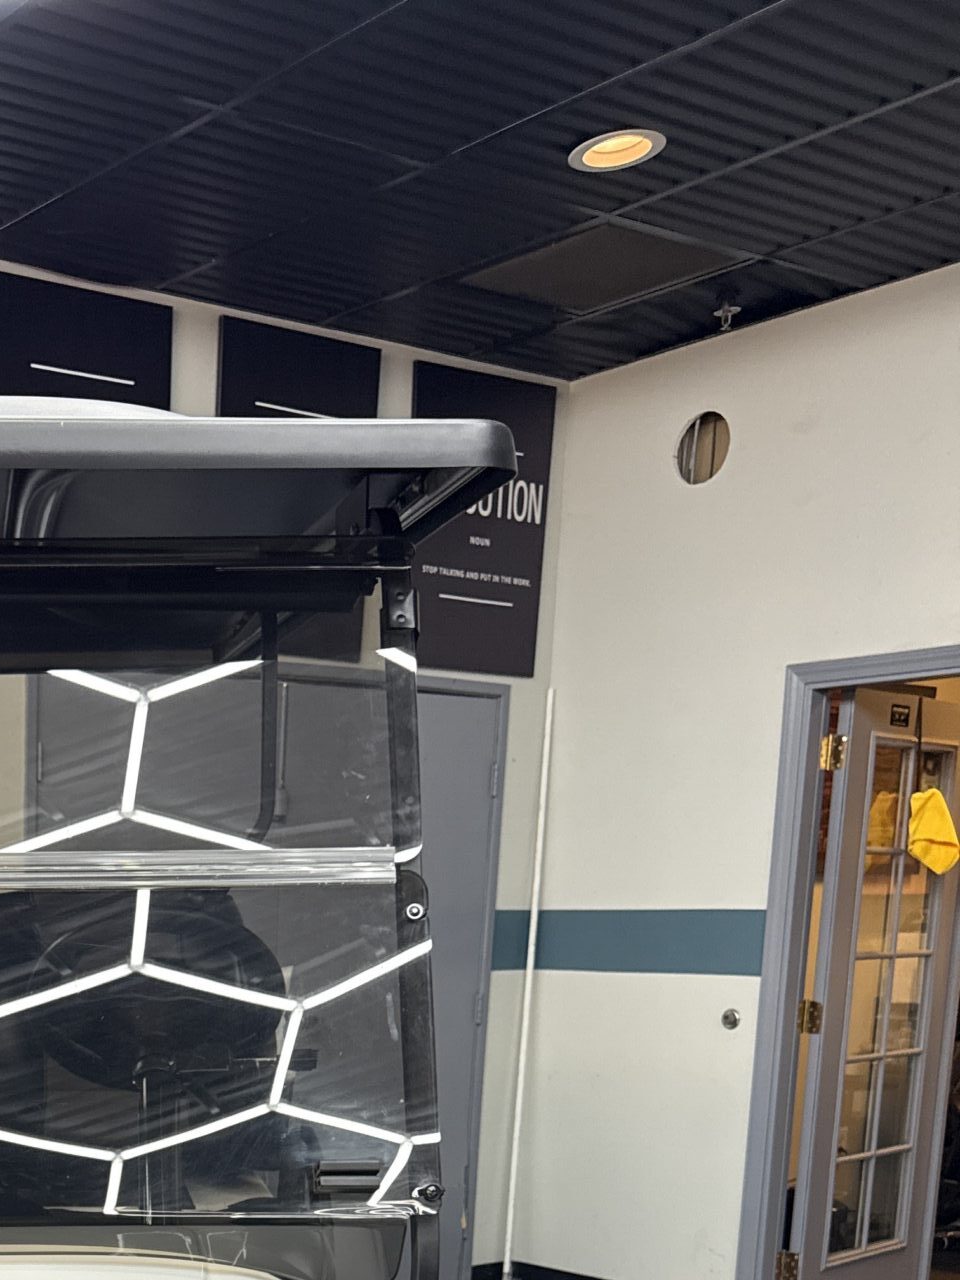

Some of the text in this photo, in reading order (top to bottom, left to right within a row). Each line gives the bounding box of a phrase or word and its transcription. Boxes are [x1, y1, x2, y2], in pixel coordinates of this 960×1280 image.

[469, 536, 491, 547] NOUN
[422, 565, 438, 574] STOP
[439, 567, 465, 578] TALKING
[466, 571, 480, 580] AND
[480, 573, 492, 582] PUT
[492, 575, 500, 583] IN
[501, 576, 512, 584] THE
